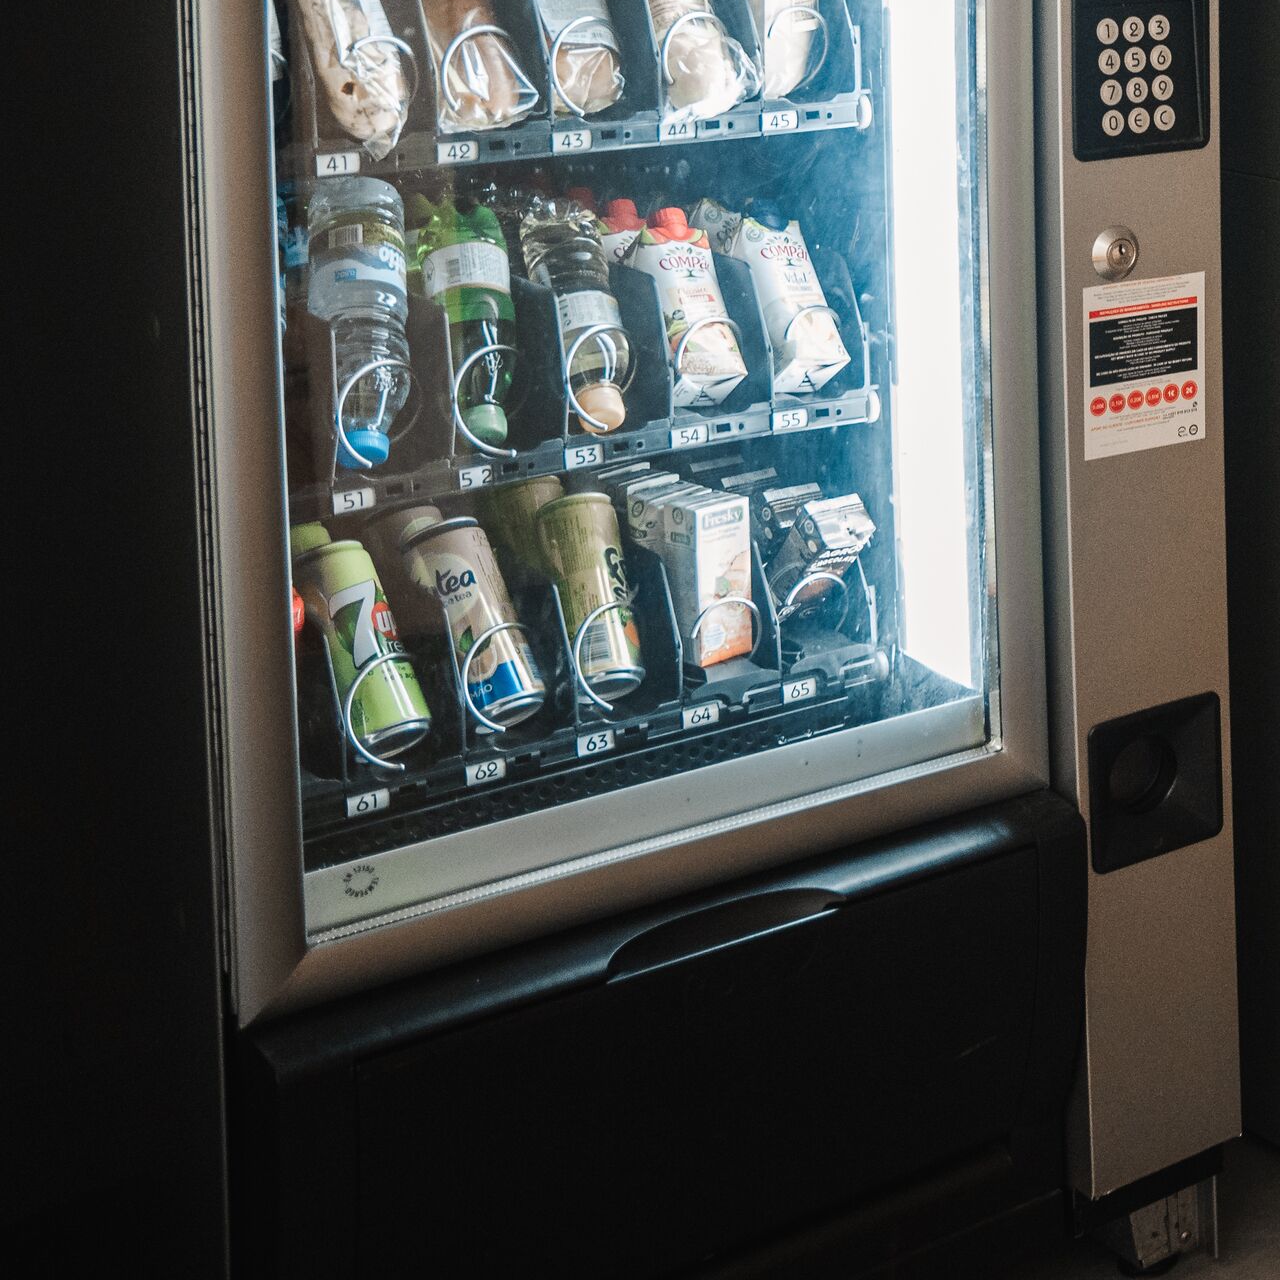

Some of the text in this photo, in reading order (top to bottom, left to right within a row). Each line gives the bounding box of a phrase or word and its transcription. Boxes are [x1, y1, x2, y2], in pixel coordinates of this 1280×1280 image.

[1105, 20, 1164, 39] 1 2 3
[1105, 50, 1166, 70] 4 5 6
[1107, 80, 1168, 101] 7 8 9
[769, 113, 791, 129] 45
[1109, 115, 1118, 131] 0
[1160, 110, 1168, 125] C
[561, 134, 584, 149] 43
[447, 143, 470, 160] 42
[326, 155, 348, 172] 41
[781, 413, 801, 428] 55
[679, 428, 700, 444] 54
[575, 448, 597, 465] 53
[343, 491, 365, 510] 51
[328, 579, 382, 670] 7
[790, 684, 810, 699] 65
[690, 708, 712, 723] 64
[586, 735, 609, 752] 63
[474, 762, 498, 780] 62
[356, 794, 378, 812] 61
